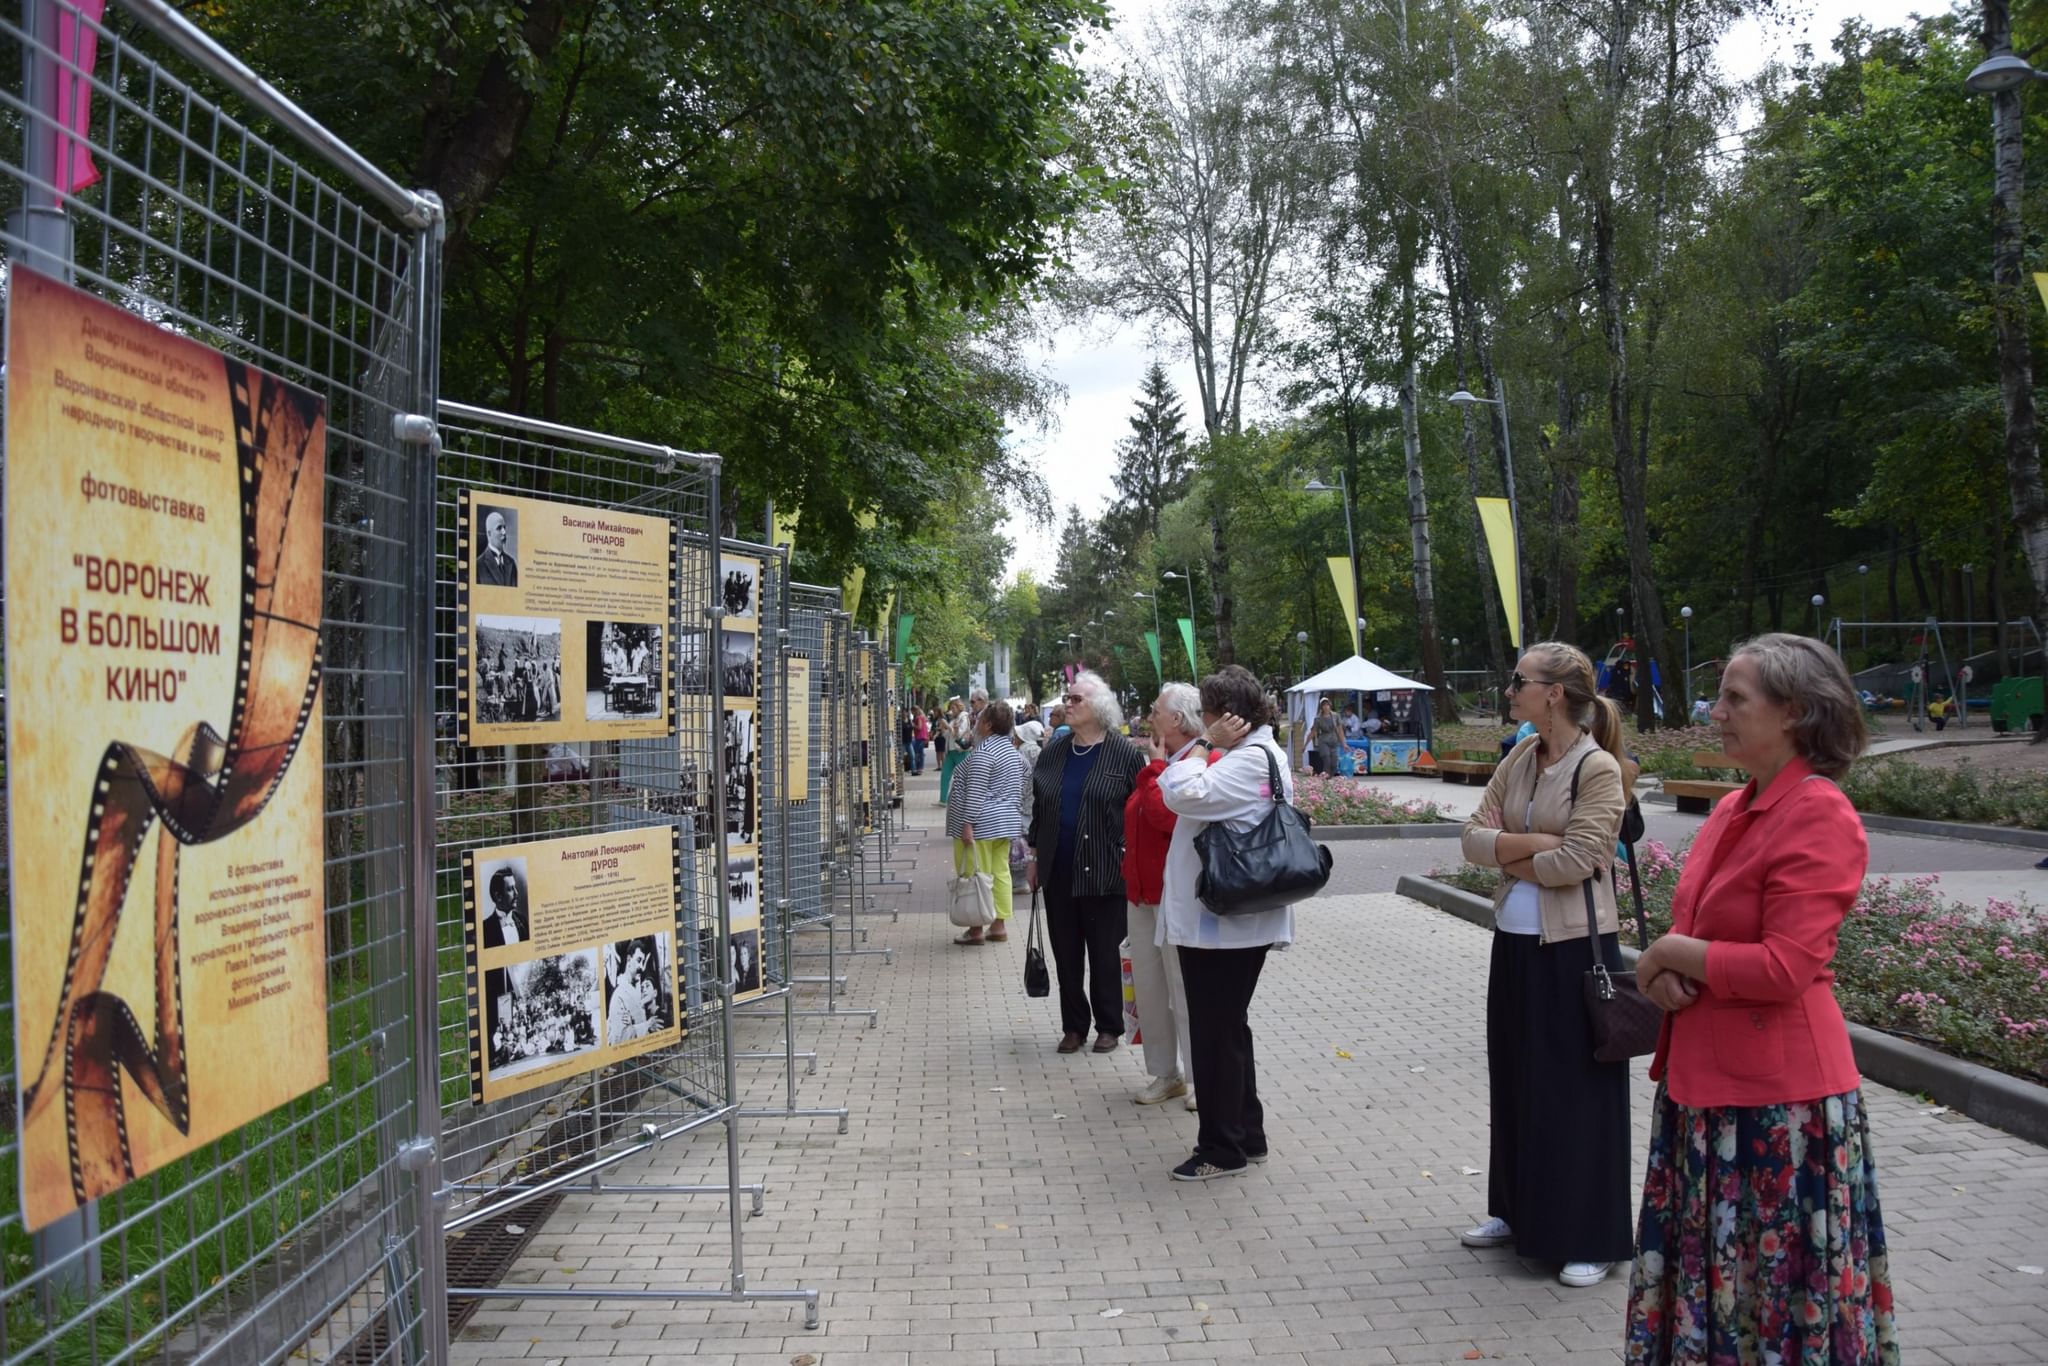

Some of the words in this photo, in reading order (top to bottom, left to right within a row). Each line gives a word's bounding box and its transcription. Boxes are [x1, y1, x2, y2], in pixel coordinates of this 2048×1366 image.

[81, 316, 159, 357] Департамент
[162, 352, 208, 382] культуры
[85, 343, 163, 387] Воронежской
[166, 377, 206, 403] области
[54, 368, 137, 412] Воронежский
[140, 401, 195, 431] областной
[197, 423, 225, 444] центр
[62, 403, 126, 434] народного
[129, 424, 188, 454] творчества
[190, 443, 197, 455] и
[199, 446, 221, 463] кино
[81, 469, 205, 523] фотовыставка
[562, 515, 596, 530] Василий
[597, 521, 643, 536] Михайлович
[582, 532, 625, 548] ГОНЧАРОВ
[60, 606, 79, 645] В
[87, 610, 221, 656] БОЛЬШОМ
[561, 847, 599, 862] Анатолий
[600, 842, 646, 856] Леонидович
[591, 857, 619, 873] ДУРОВ
